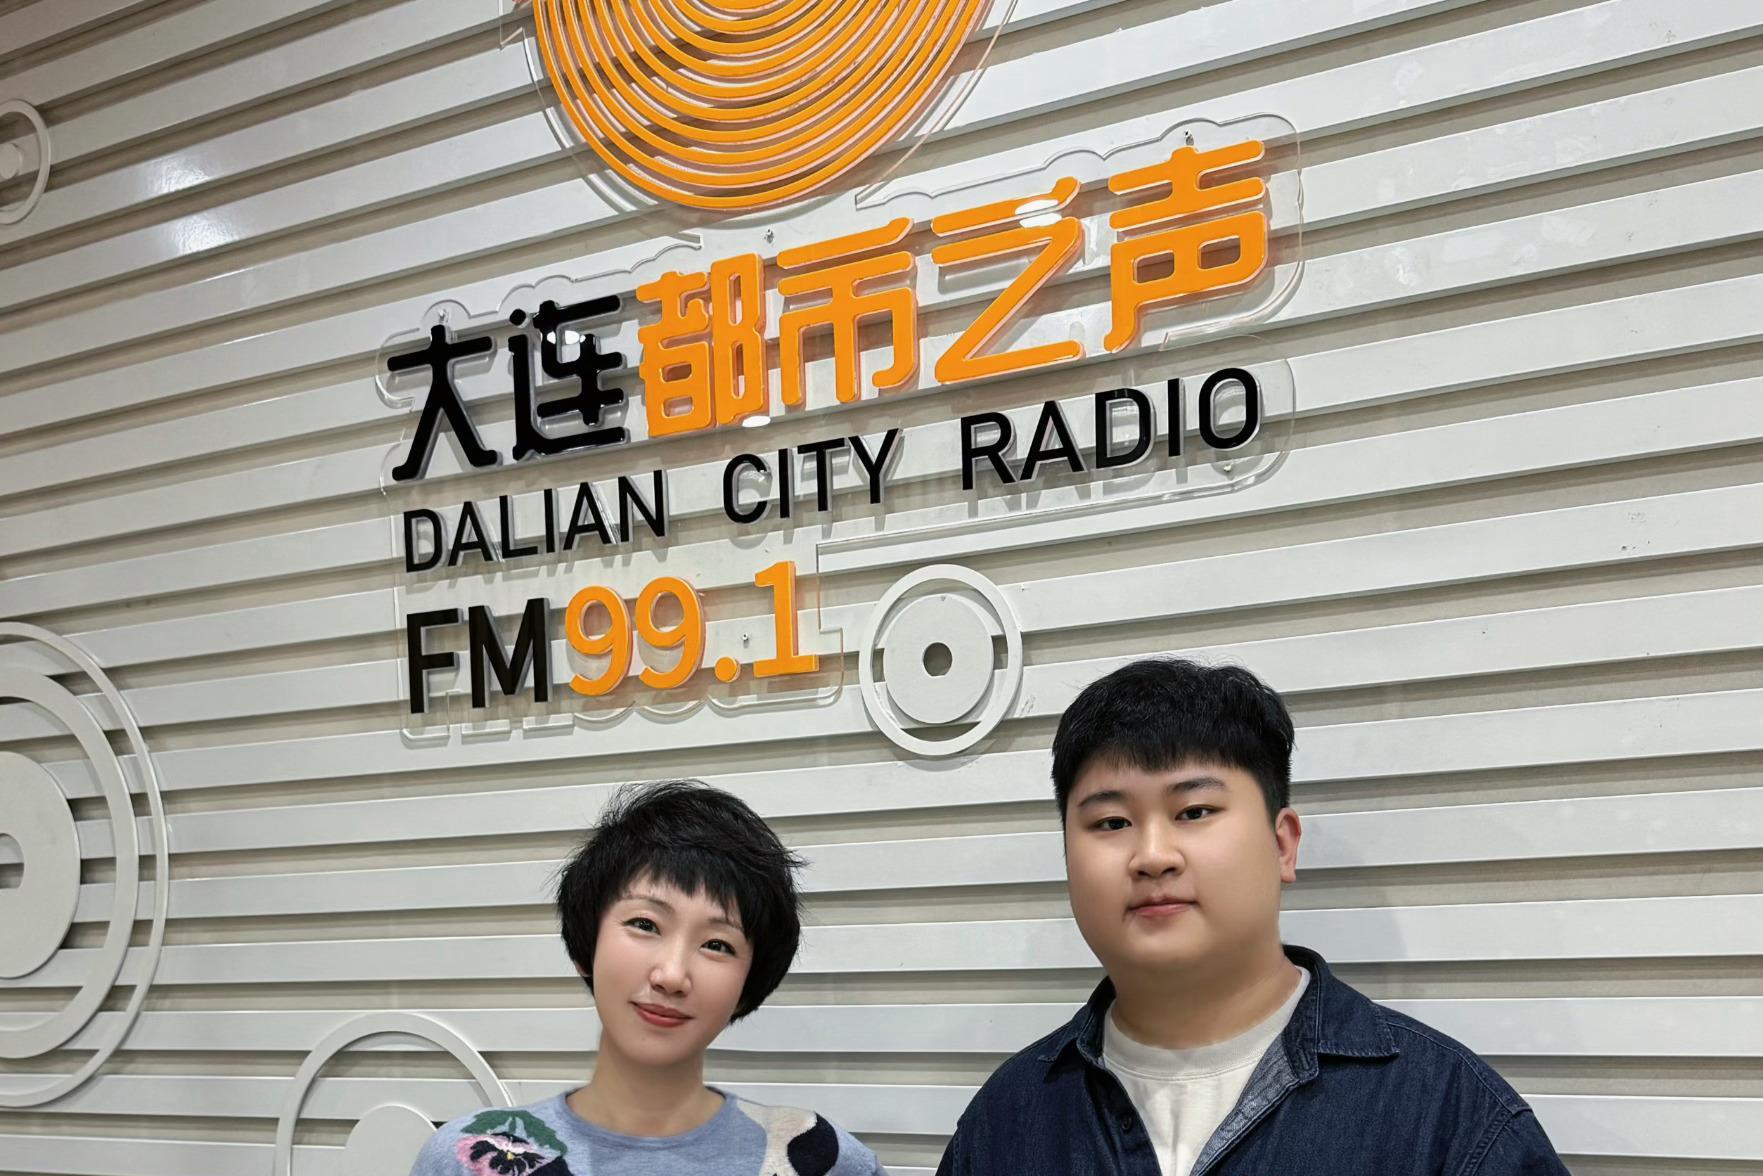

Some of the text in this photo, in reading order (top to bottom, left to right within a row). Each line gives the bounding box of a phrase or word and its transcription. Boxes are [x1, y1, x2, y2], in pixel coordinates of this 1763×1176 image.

[387, 140, 1270, 481] 大连都市之声
[403, 366, 1263, 573] DALIAN CITY RADIO
